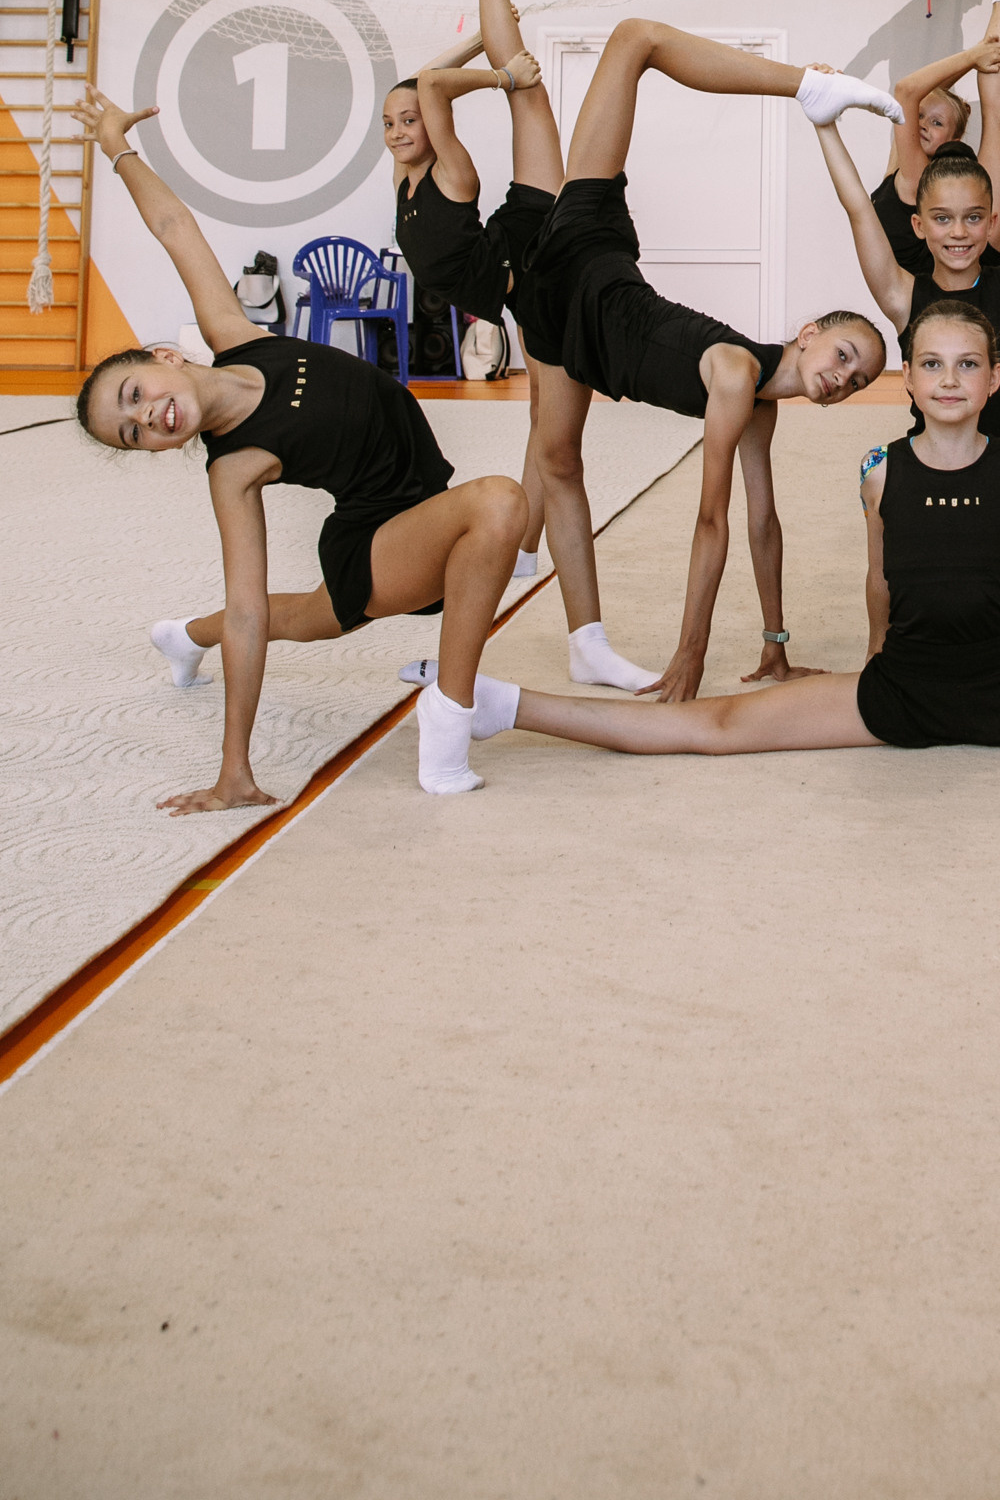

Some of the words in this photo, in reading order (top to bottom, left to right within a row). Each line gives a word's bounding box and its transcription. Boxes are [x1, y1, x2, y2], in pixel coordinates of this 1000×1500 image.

[232, 42, 288, 150] 1
[290, 358, 307, 408] Angel
[925, 496, 980, 508] Angel
